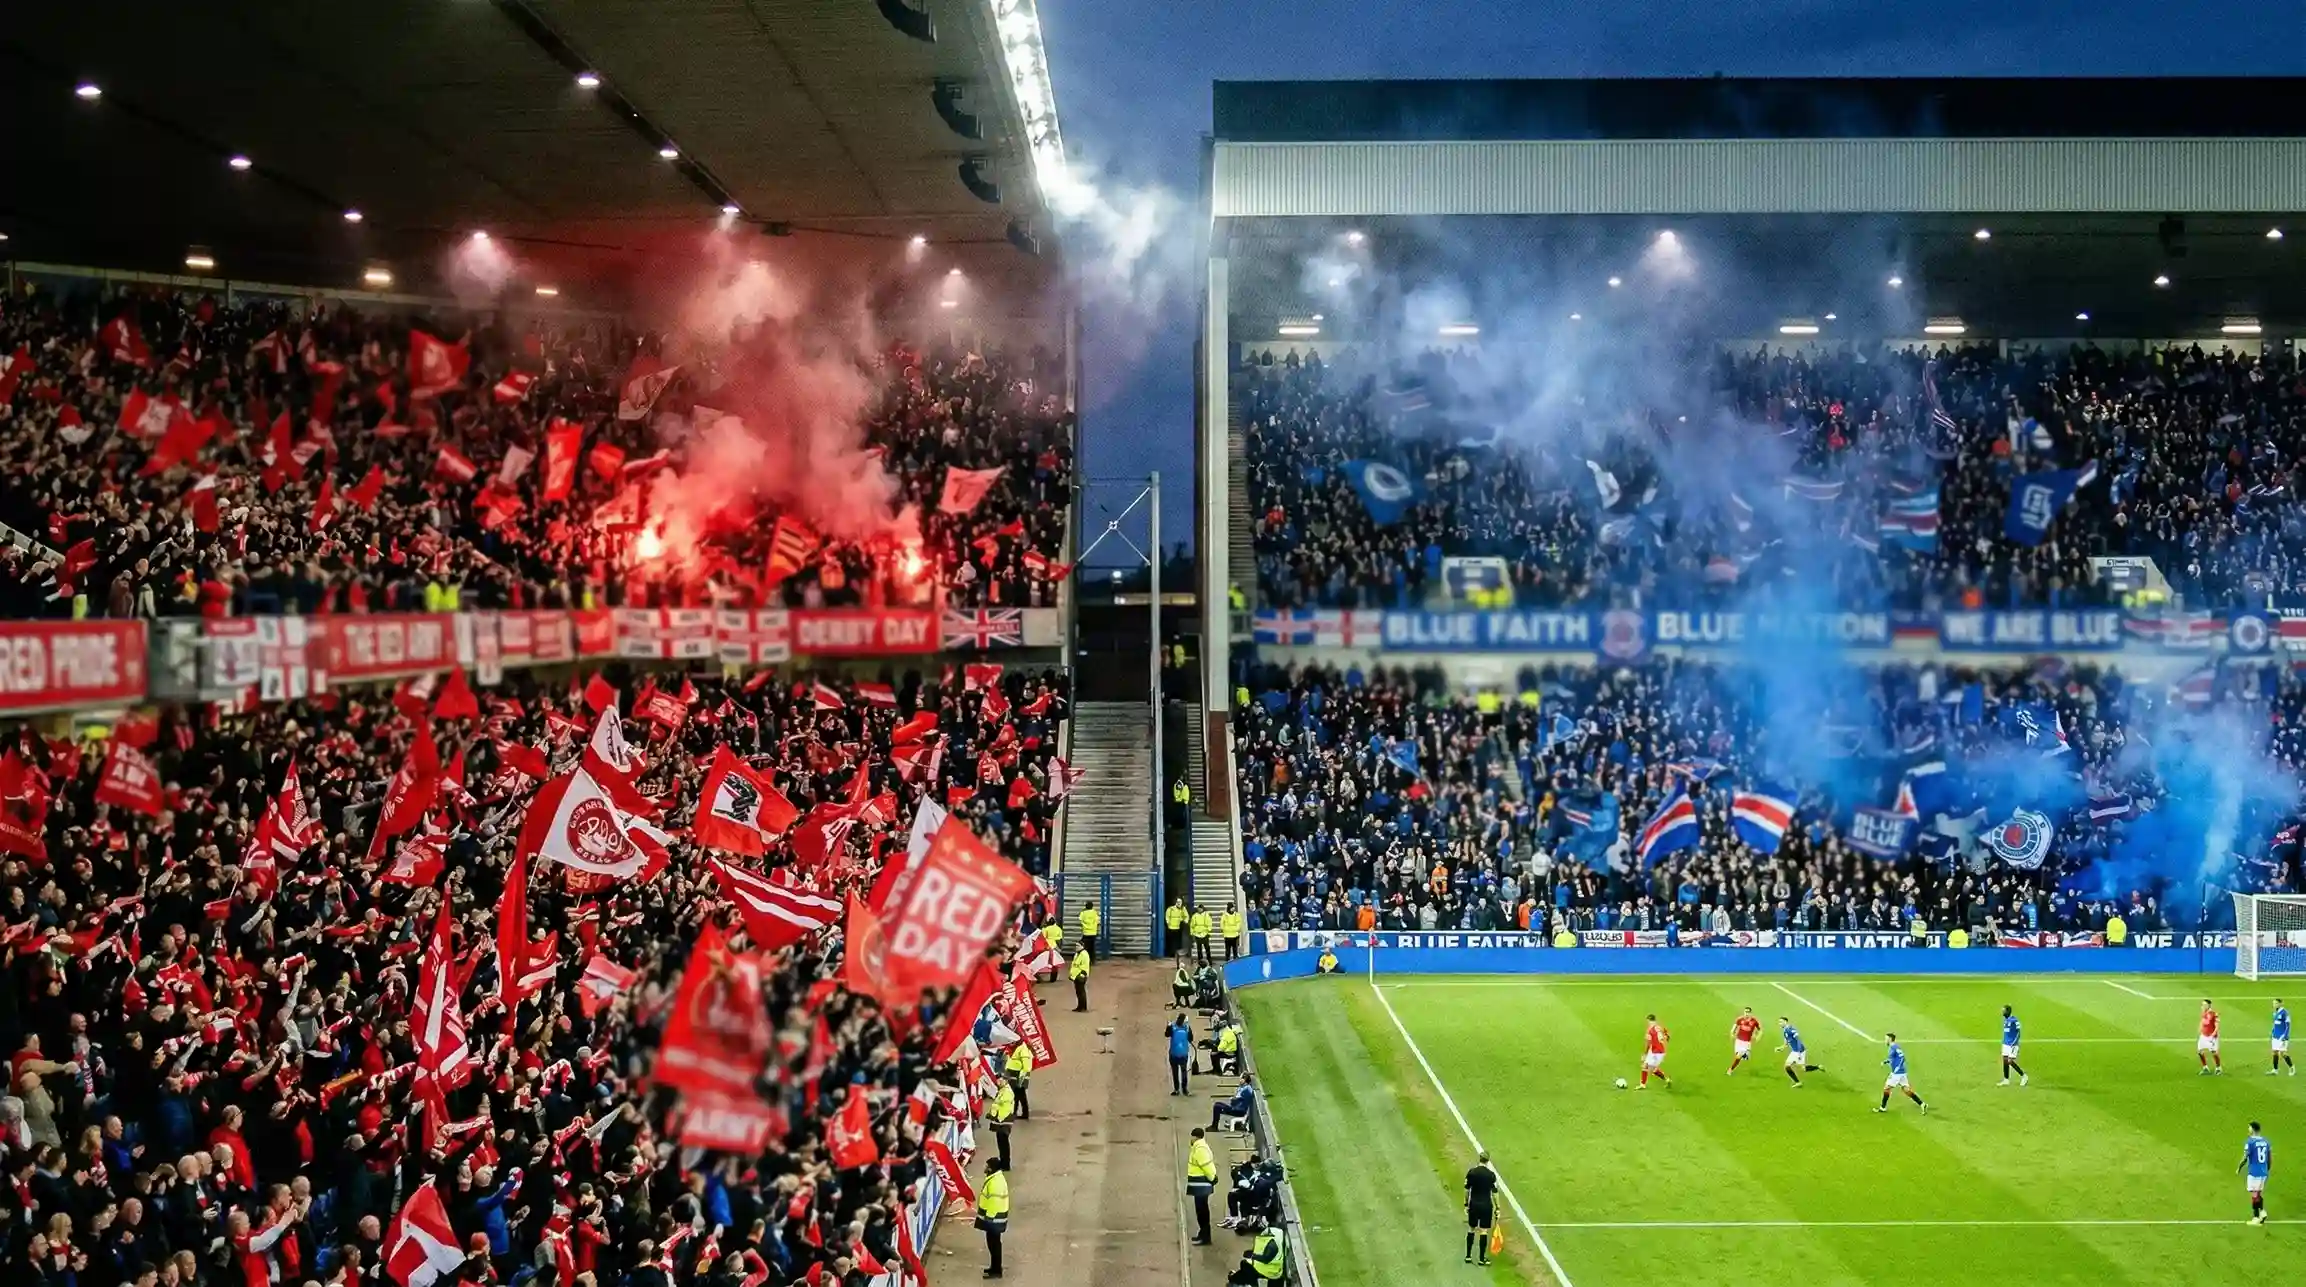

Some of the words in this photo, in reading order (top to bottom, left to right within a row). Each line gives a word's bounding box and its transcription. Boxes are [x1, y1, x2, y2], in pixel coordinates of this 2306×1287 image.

[883, 616, 929, 645] DAY
[1388, 613, 1476, 642] BLUE
[1489, 614, 1588, 643] FAITH
[1657, 612, 1745, 641] BLUE
[2051, 614, 2119, 644] BLUE
[1855, 812, 1904, 832] BLUE
[1853, 827, 1900, 847] BLUE
[908, 866, 1004, 942] RED
[890, 920, 984, 976] DAY
[2134, 935, 2172, 948] WE
